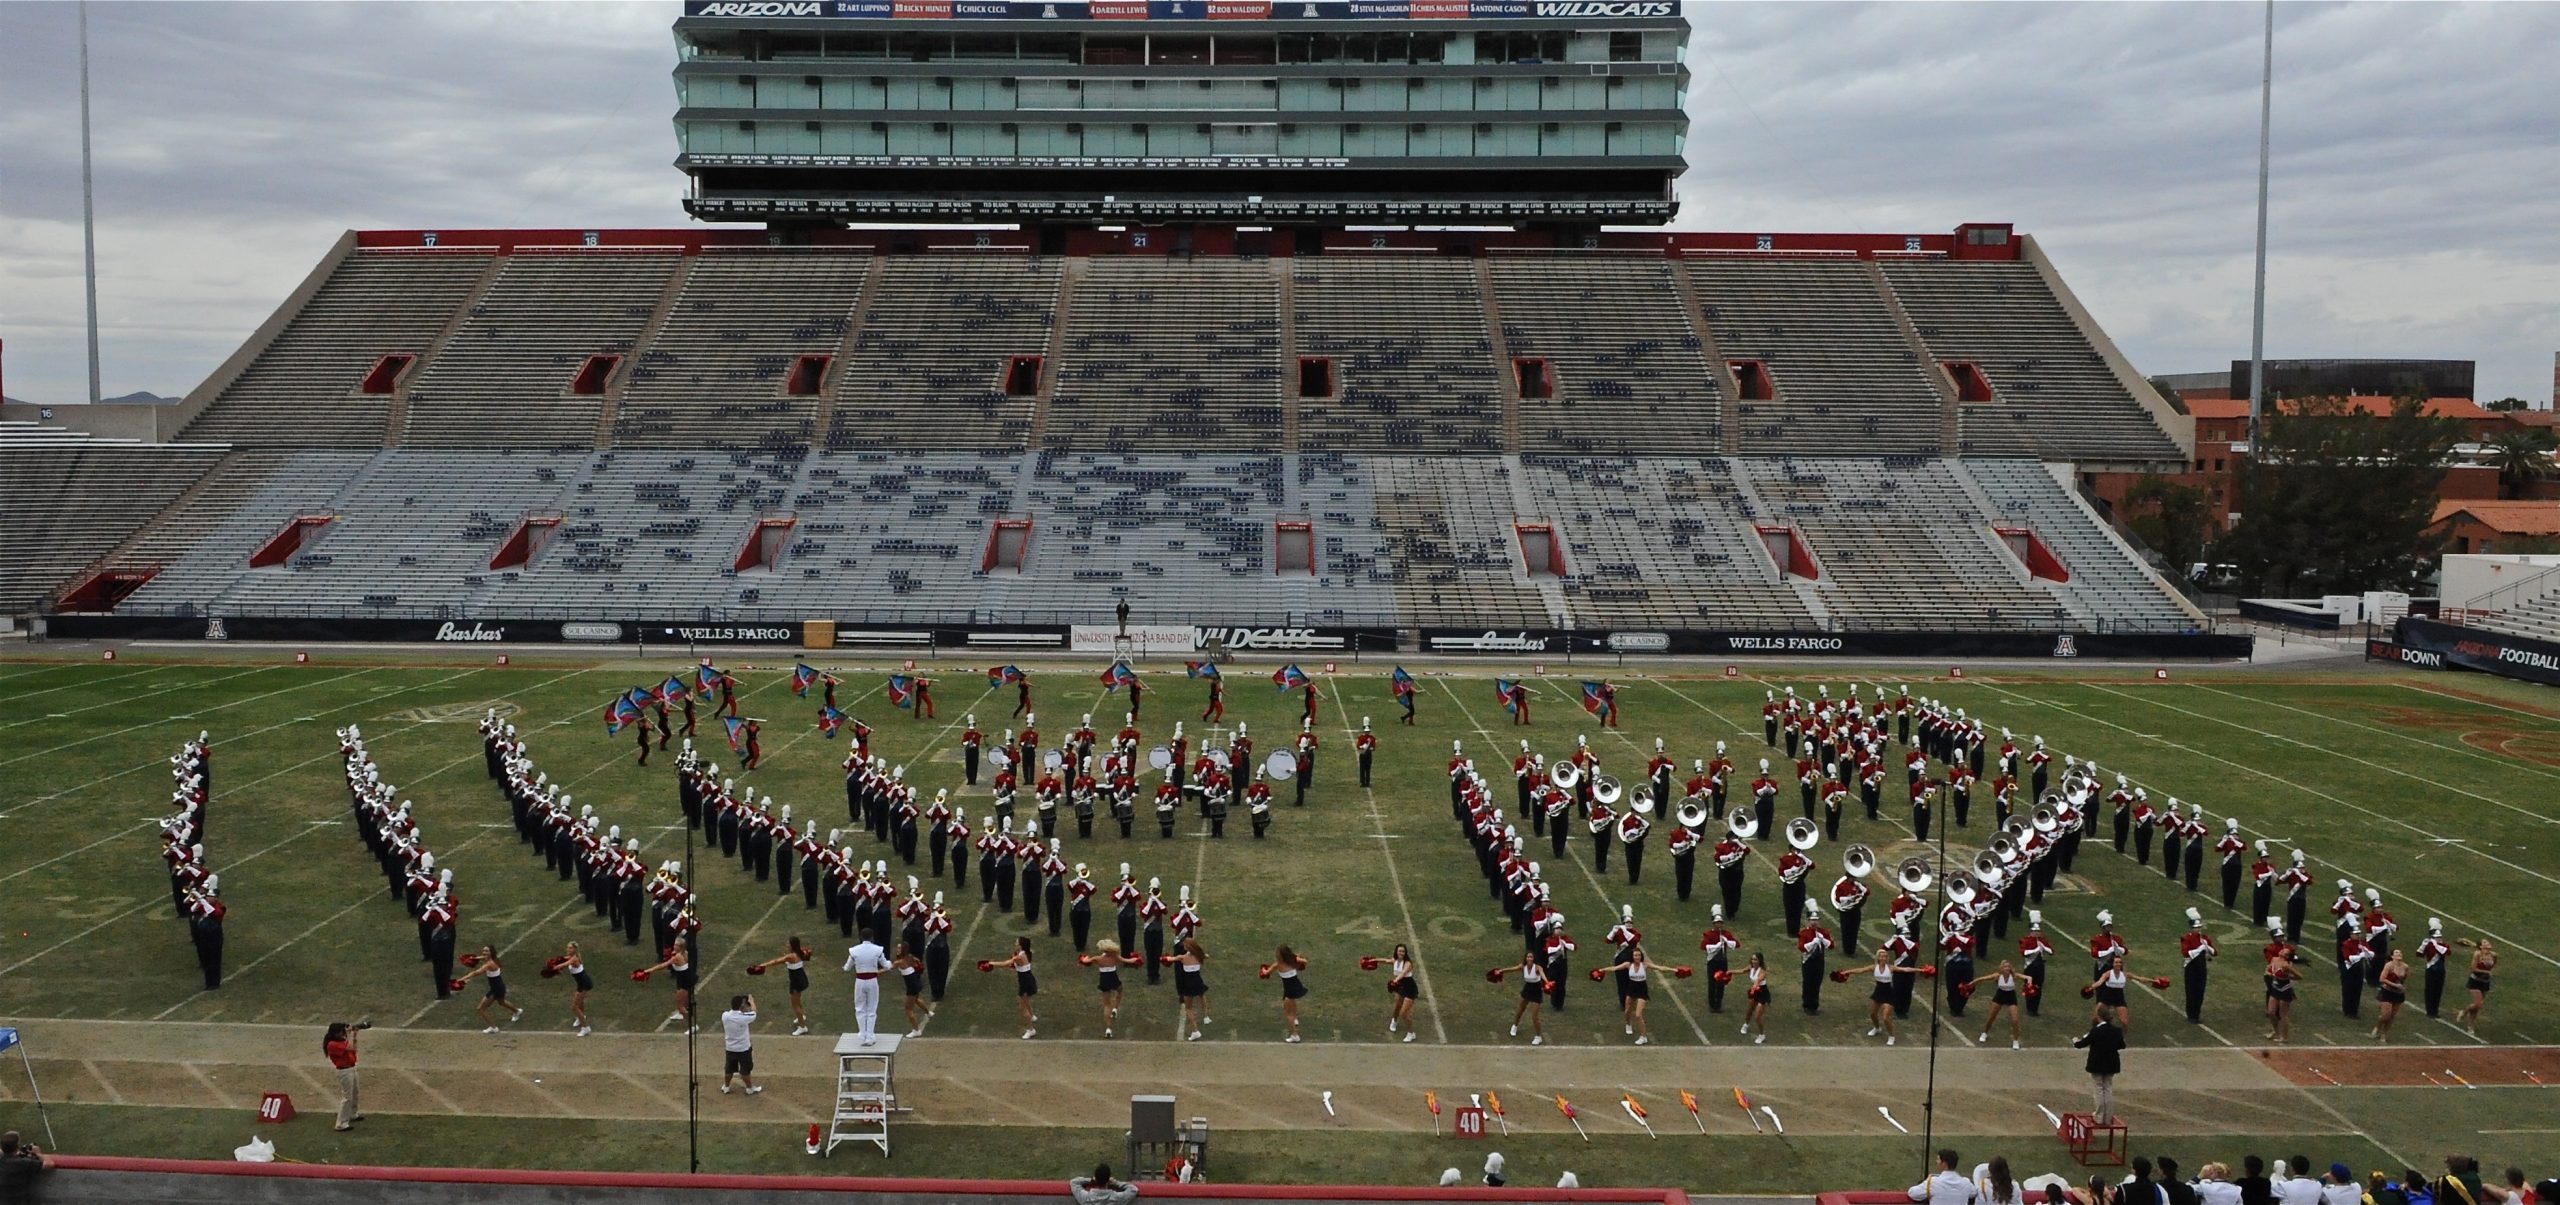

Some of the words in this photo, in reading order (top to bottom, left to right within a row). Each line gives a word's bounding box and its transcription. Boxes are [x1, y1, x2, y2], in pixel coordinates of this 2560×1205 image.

[698, 3, 822, 16] ARIZONA
[838, 4, 846, 12] 22
[847, 4, 860, 12] ART
[962, 5, 986, 13] CHUCK
[1090, 6, 1095, 14] 4
[1096, 6, 1125, 14] DARRYLL
[1127, 6, 1147, 14] LEWIS
[1233, 5, 1265, 13] WALDROP
[1350, 4, 1359, 12] 28
[1475, 5, 1503, 13] ANTOINE
[1536, 3, 1674, 16] WILDCATS
[425, 238, 435, 247] 17
[584, 237, 598, 246] 18
[976, 237, 990, 246] 20
[1134, 238, 1146, 247] 21
[1372, 239, 1385, 248] 22
[1584, 239, 1597, 248] 23
[1757, 240, 1772, 250] 24
[1906, 242, 1920, 251] 25
[41, 409, 53, 418] 16
[435, 621, 505, 641] Bashas'
[583, 627, 616, 635] CASINOS
[679, 628, 734, 640] WELLS
[737, 628, 791, 640] FARGO
[1074, 631, 1111, 643] UNIVERSITY
[1156, 632, 1176, 643] BAND
[1177, 632, 1192, 643] DAY
[1195, 628, 1315, 649] WILDCATS
[1629, 637, 1664, 645] CASINOS
[1728, 638, 1785, 649] WELLS
[1787, 638, 1843, 650] FARGO
[2498, 648, 2560, 670] FOOTBALL
[261, 1097, 281, 1120] 40
[1460, 1112, 1480, 1133] 40
